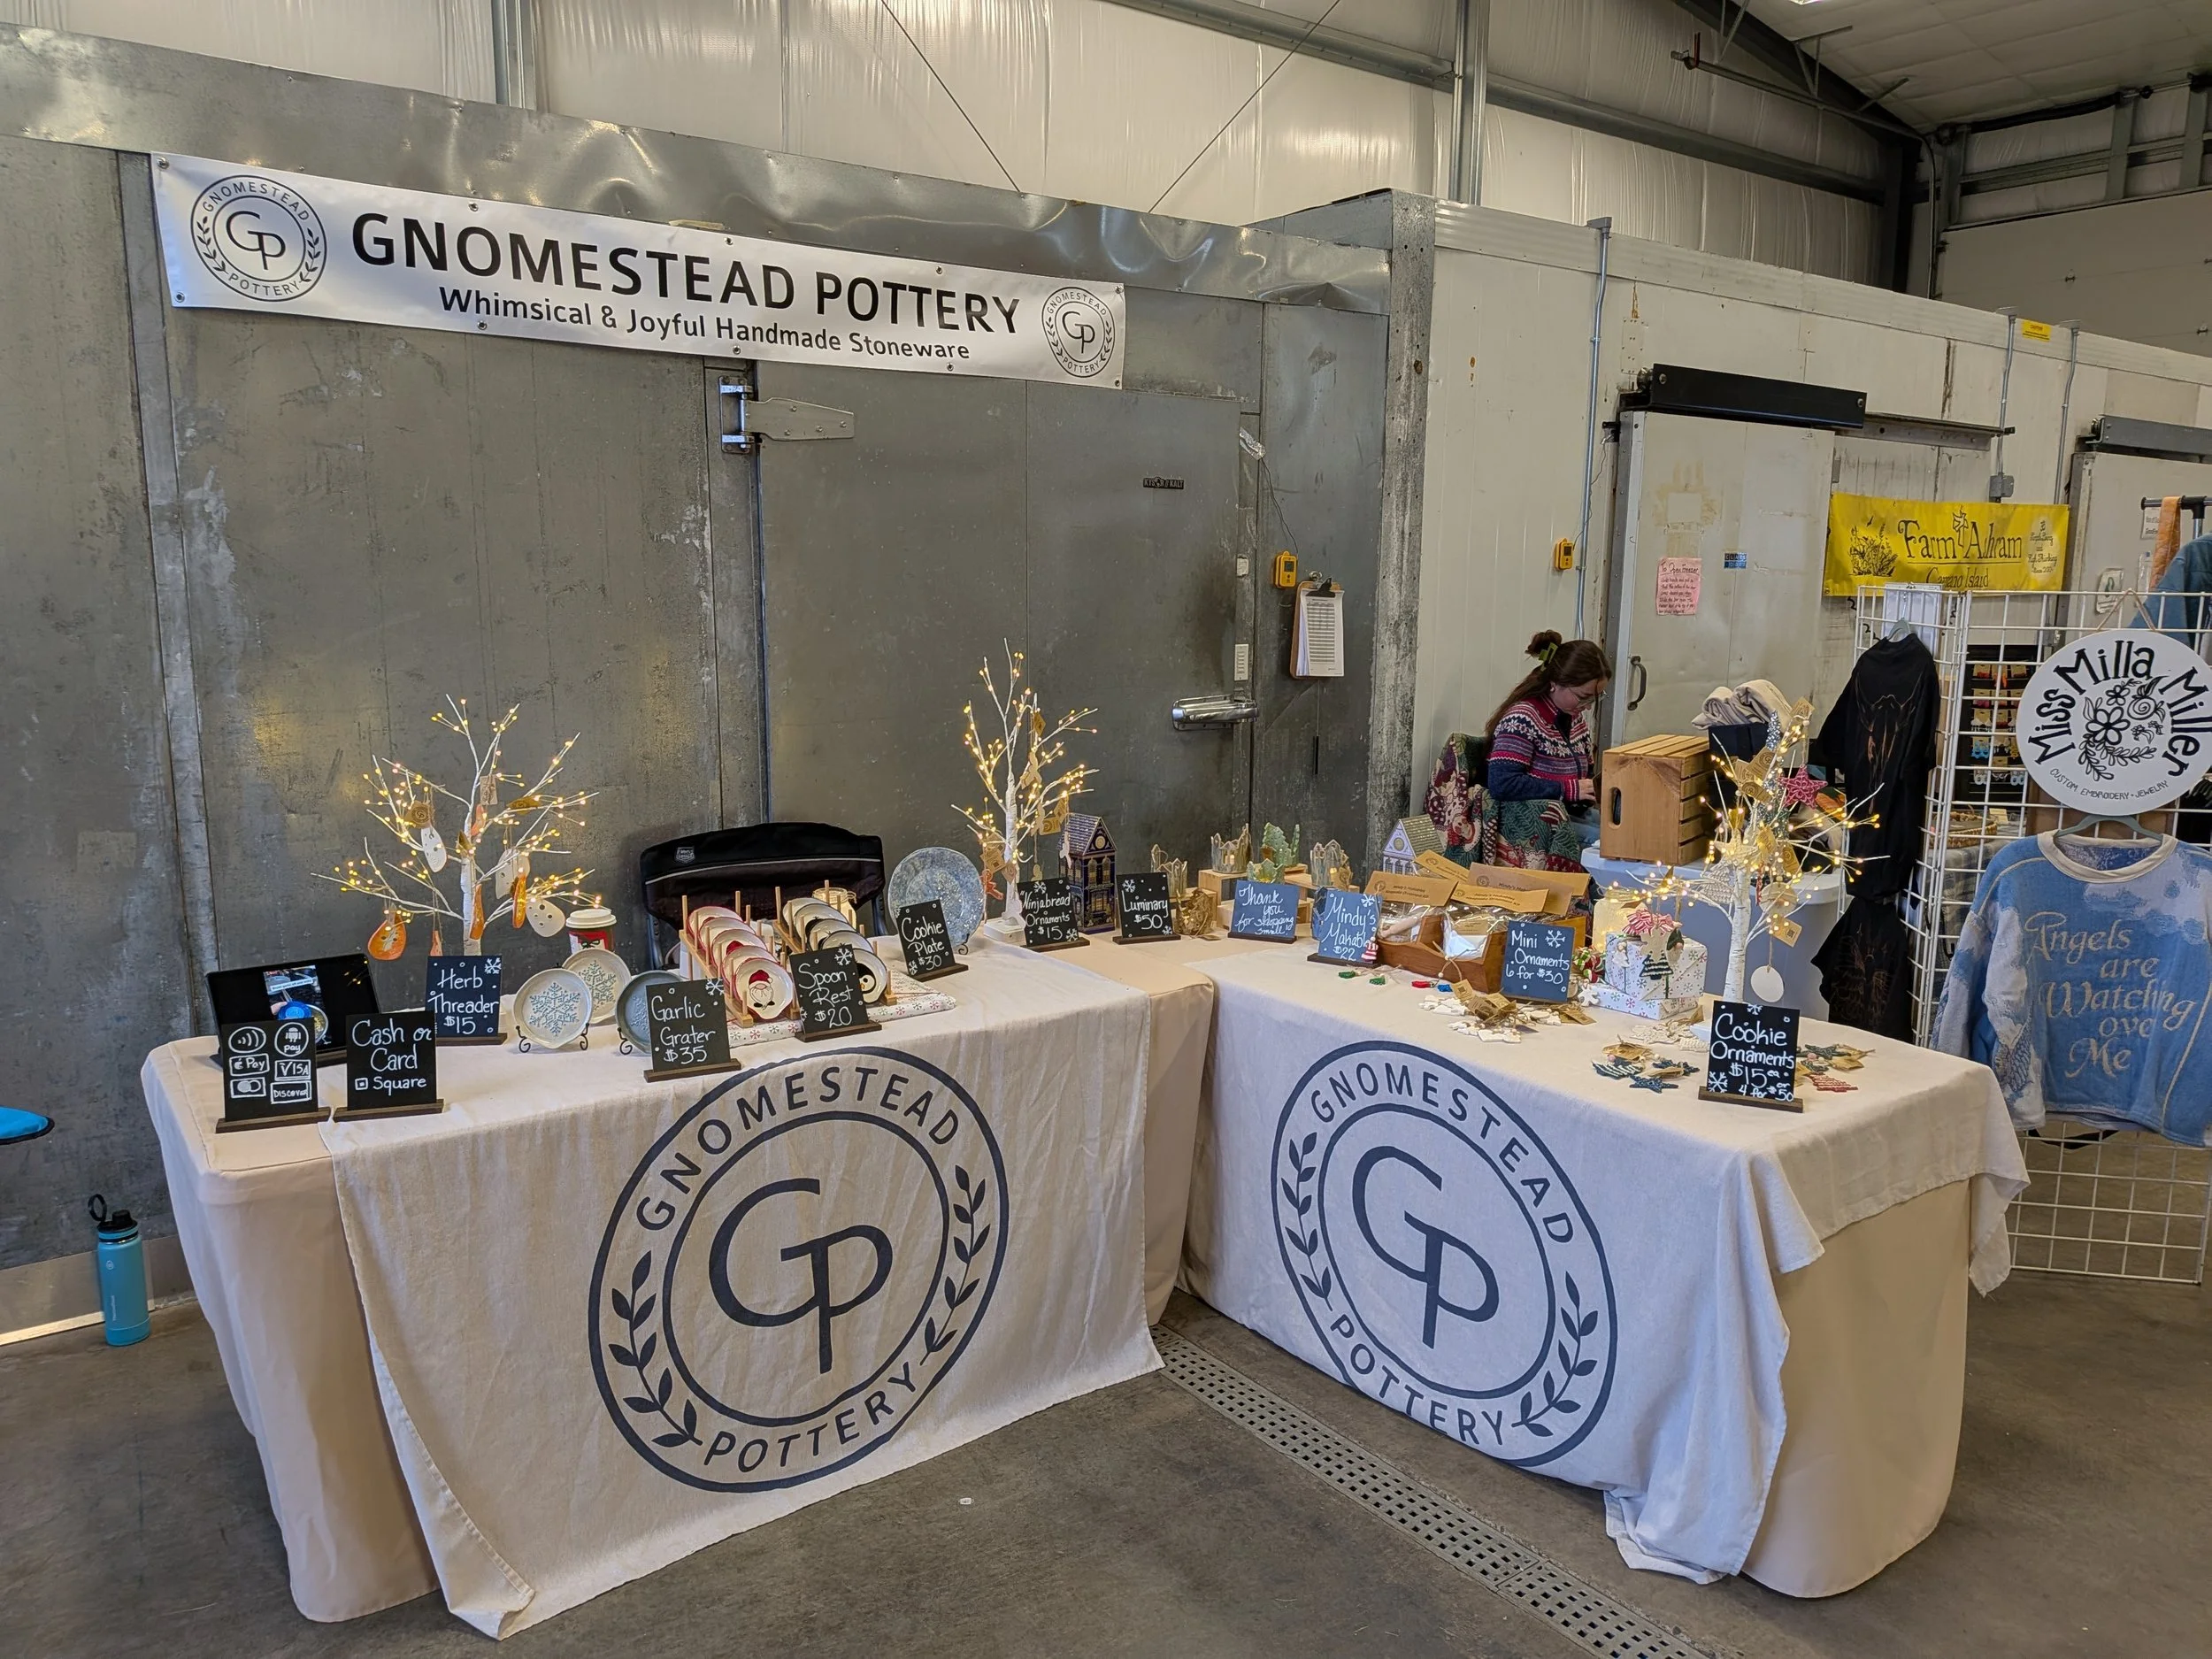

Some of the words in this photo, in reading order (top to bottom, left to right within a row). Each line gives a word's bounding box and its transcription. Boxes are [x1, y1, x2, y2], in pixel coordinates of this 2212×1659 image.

[203, 180, 311, 223] GNOMESTEAD
[227, 270, 300, 297] POTTERY
[352, 212, 795, 310] GNOMESTEAD
[816, 271, 1021, 334] POTTERY
[1047, 290, 1108, 317] GNOMESTEAD
[439, 286, 592, 326] Whimsical
[601, 306, 618, 329] &
[626, 308, 706, 341] Joyful
[716, 317, 842, 351] Handmade
[849, 331, 971, 360] Stoneware
[1062, 356, 1102, 374] POTTERY
[1897, 519, 1957, 559] Farm
[2028, 688, 2076, 764] Miss
[2054, 640, 2154, 695] Milla
[2158, 665, 2212, 777] Miller
[2049, 768, 2078, 792] CUSTOM
[2080, 787, 2129, 800] EMBROIDERY
[2135, 780, 2169, 798] JEWELRY
[1121, 890, 1169, 918] Luminary
[1239, 884, 1283, 906] Thank
[1263, 904, 1284, 916] you
[1325, 896, 1376, 937] Mindy's
[901, 916, 945, 942] Cookie
[1038, 926, 1063, 940] $15
[1133, 914, 1164, 930] $50
[1234, 913, 1255, 933] for
[907, 938, 945, 956] Plate
[1511, 930, 1538, 949] Mini
[2024, 910, 2133, 965] Angels
[918, 955, 942, 970] $30
[1333, 946, 1356, 962] $22
[1514, 948, 1571, 971] Ornaments
[437, 965, 483, 989] Herb
[798, 963, 848, 992] Spoon
[1506, 964, 1515, 977] 6
[1517, 965, 1534, 979] for
[1537, 968, 1563, 984] $30
[2100, 956, 2161, 979] are
[427, 993, 499, 1013] Threader
[809, 985, 854, 1007] Rest
[651, 995, 705, 1022] Garlic
[814, 1006, 852, 1028] $20
[352, 1018, 405, 1047] Cash
[413, 1027, 432, 1041] or
[443, 1015, 476, 1034] $15
[660, 1025, 716, 1047] Grater
[1715, 1012, 1787, 1046] Cookie
[284, 1045, 301, 1054] pay
[371, 1043, 418, 1071] Card
[664, 1045, 707, 1064] $35
[1710, 1041, 1794, 1069] Ornaments
[2065, 1037, 2134, 1079] Me
[246, 1057, 265, 1071] Pay
[280, 1062, 309, 1076] VISA
[1728, 1062, 1767, 1088] $15
[273, 1089, 308, 1098] DISCOVER
[373, 1076, 426, 1095] Square
[1739, 1084, 1747, 1095] 4
[1750, 1087, 1768, 1099] for
[1766, 1086, 1794, 1102] $50
[636, 1065, 960, 1231] GNOMESTEAD
[1310, 1062, 1574, 1244] GNOMESTEAD
[1330, 1313, 1505, 1447] POTTERY
[703, 1360, 917, 1473] POTTERY
